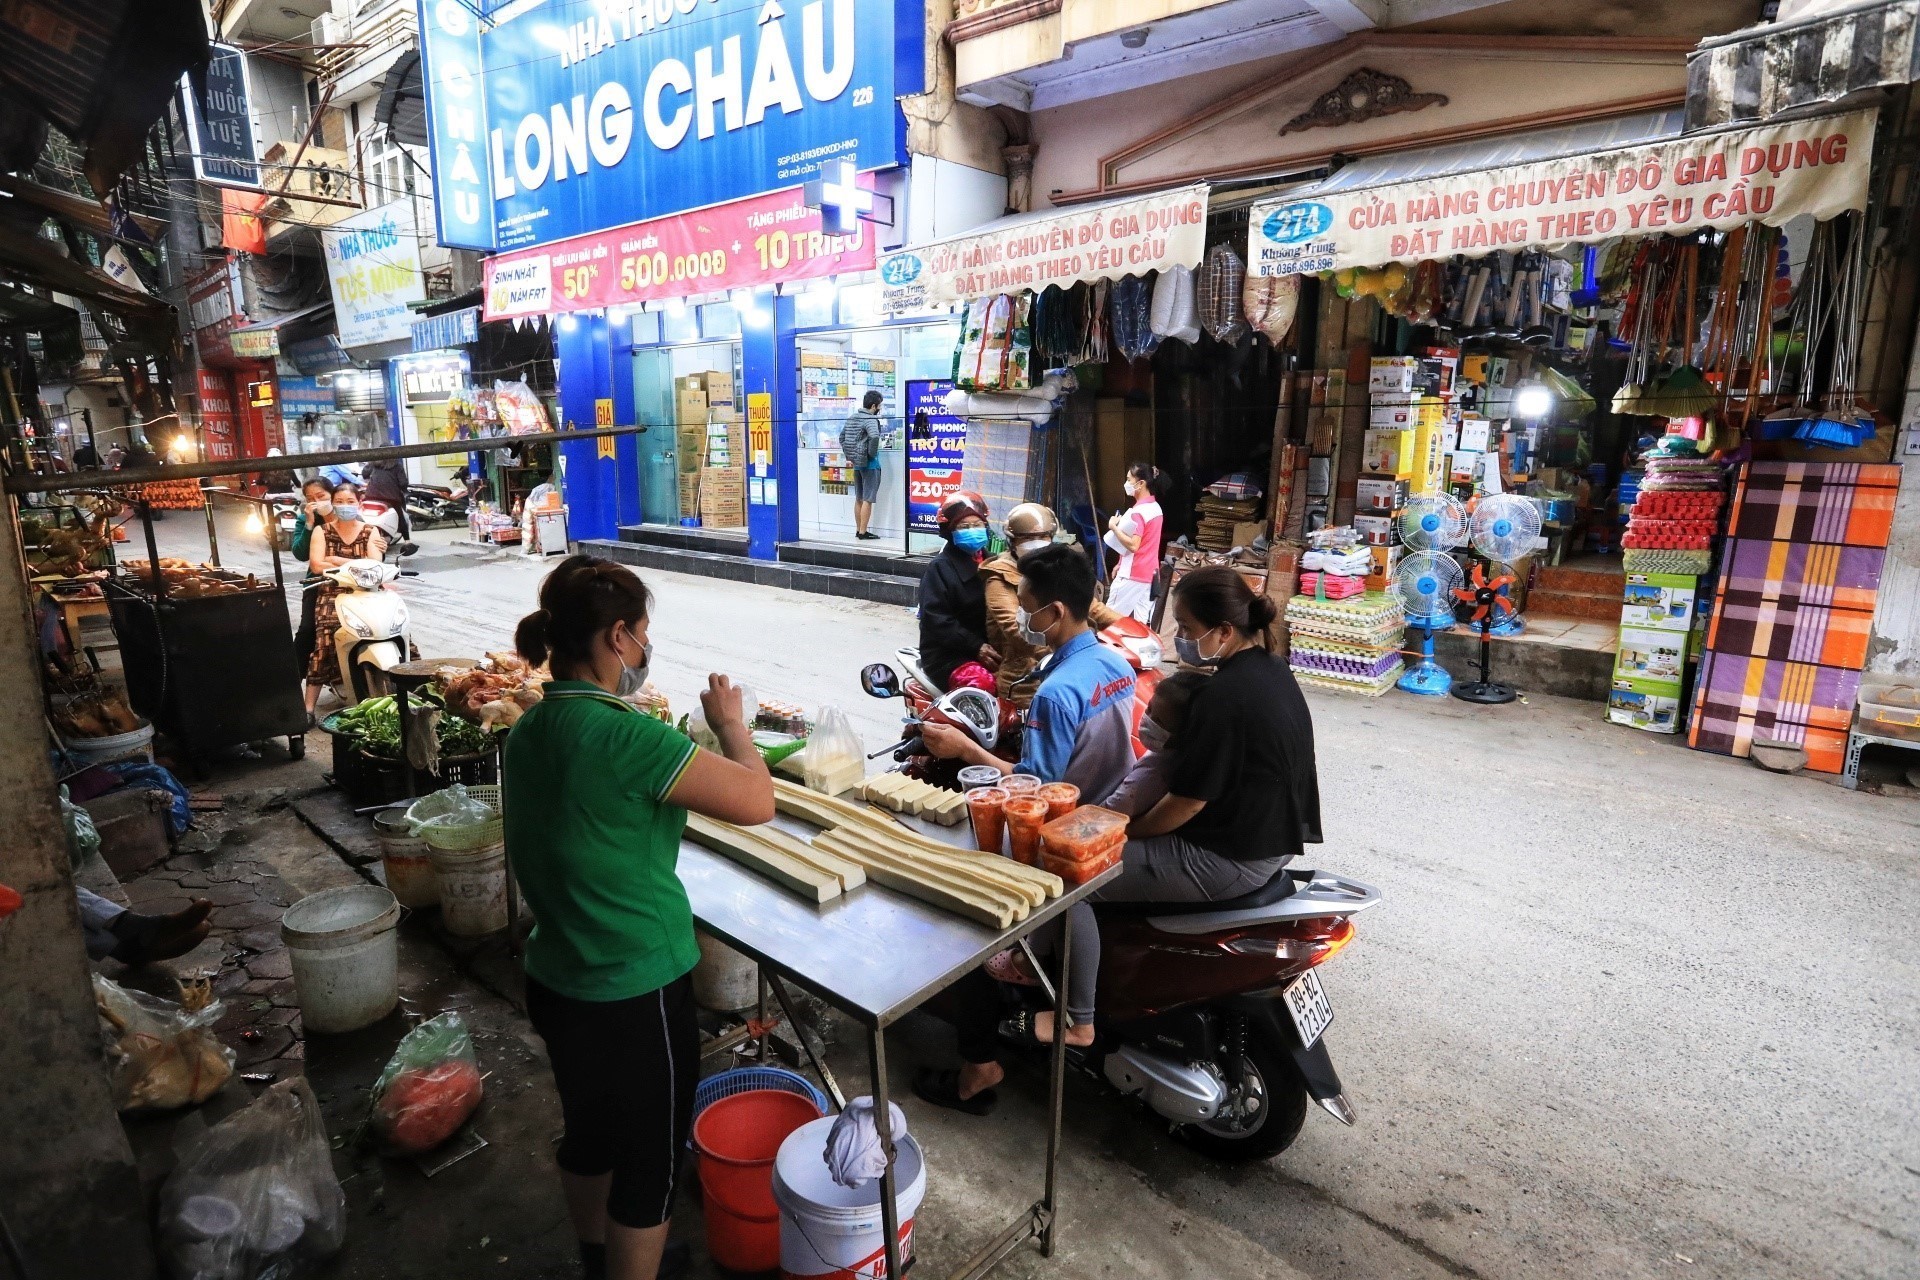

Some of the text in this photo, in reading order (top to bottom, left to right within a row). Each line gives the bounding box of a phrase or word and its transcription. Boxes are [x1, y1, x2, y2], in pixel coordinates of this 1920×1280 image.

[491, 0, 855, 201] LONG CHÂU
[852, 86, 874, 107] 226
[208, 119, 242, 150] TUỆ
[1349, 132, 1848, 230] CỬA HÀNG CHUYÊN ĐỒ GIA DỤNG
[746, 210, 775, 232] TẶNG
[775, 200, 809, 224] PHIẾU
[1276, 206, 1320, 238] 274
[1390, 176, 1776, 262] ĐẶT HÀNG THEO YÊU CẦU
[592, 242, 609, 257] ĐẾN
[754, 230, 791, 271] 10
[931, 201, 1203, 275] CỬA HÀNG CHUYÊN ĐỒ GIA DỤNG
[1261, 241, 1337, 260] Khương Trung
[494, 263, 537, 284] SINH NHẬT
[888, 257, 915, 282] 274
[955, 233, 1167, 299] ĐẶT HÀNG THEO YÊU CẦU
[1260, 258, 1333, 277] ĐT: 0366.896.896
[492, 286, 509, 312] 10
[528, 287, 547, 301] FRT
[202, 376, 226, 390] NHA
[202, 398, 232, 412] KHOA
[597, 402, 611, 425] GIÁ
[749, 401, 770, 420] THUỐC
[209, 421, 230, 440] LẠC
[750, 422, 770, 451] TỐT
[909, 436, 966, 453] TRỢ GIÁ
[1103, 675, 1133, 698] HONDA
[1290, 972, 1319, 1014] 89-B2
[1299, 996, 1331, 1043] 123.04
